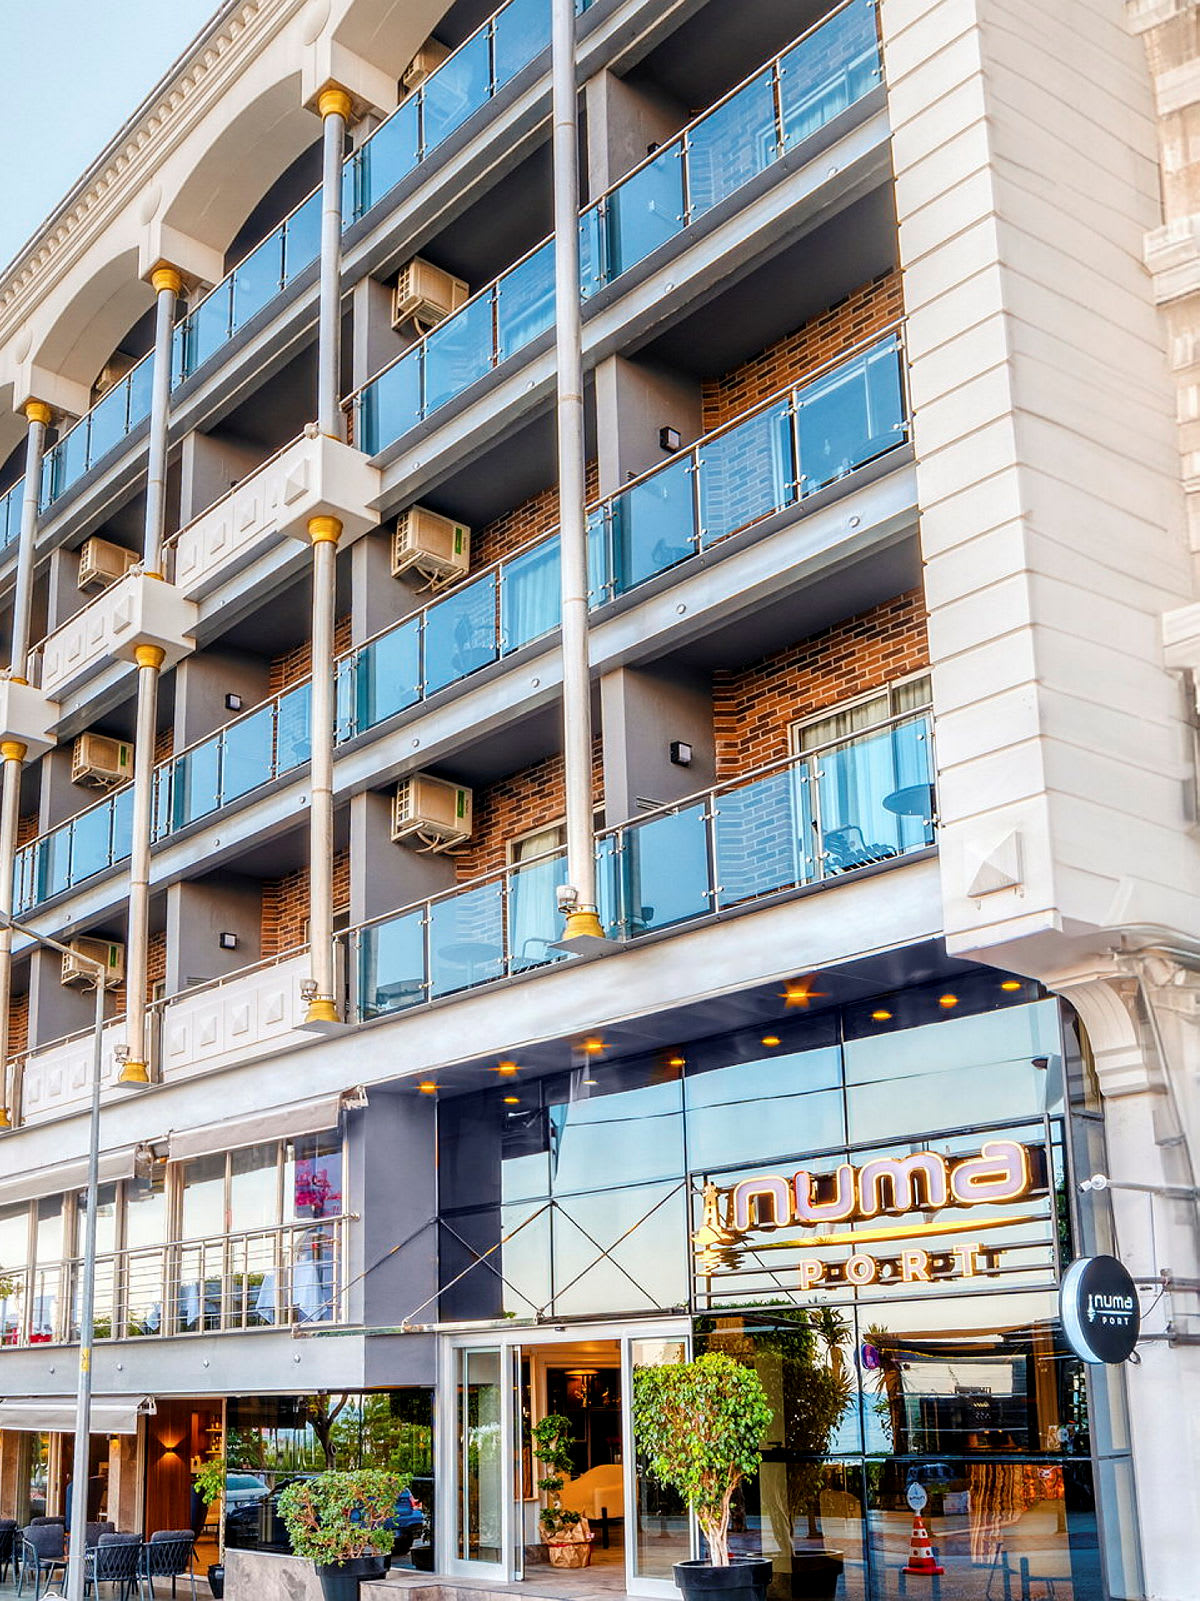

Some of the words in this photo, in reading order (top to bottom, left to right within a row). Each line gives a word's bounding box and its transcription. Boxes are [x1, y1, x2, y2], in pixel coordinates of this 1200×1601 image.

[734, 1140, 1028, 1232] numa
[800, 1243, 984, 1290] PORT
[1094, 1294, 1133, 1309] numa
[1102, 1316, 1129, 1326] PORT
